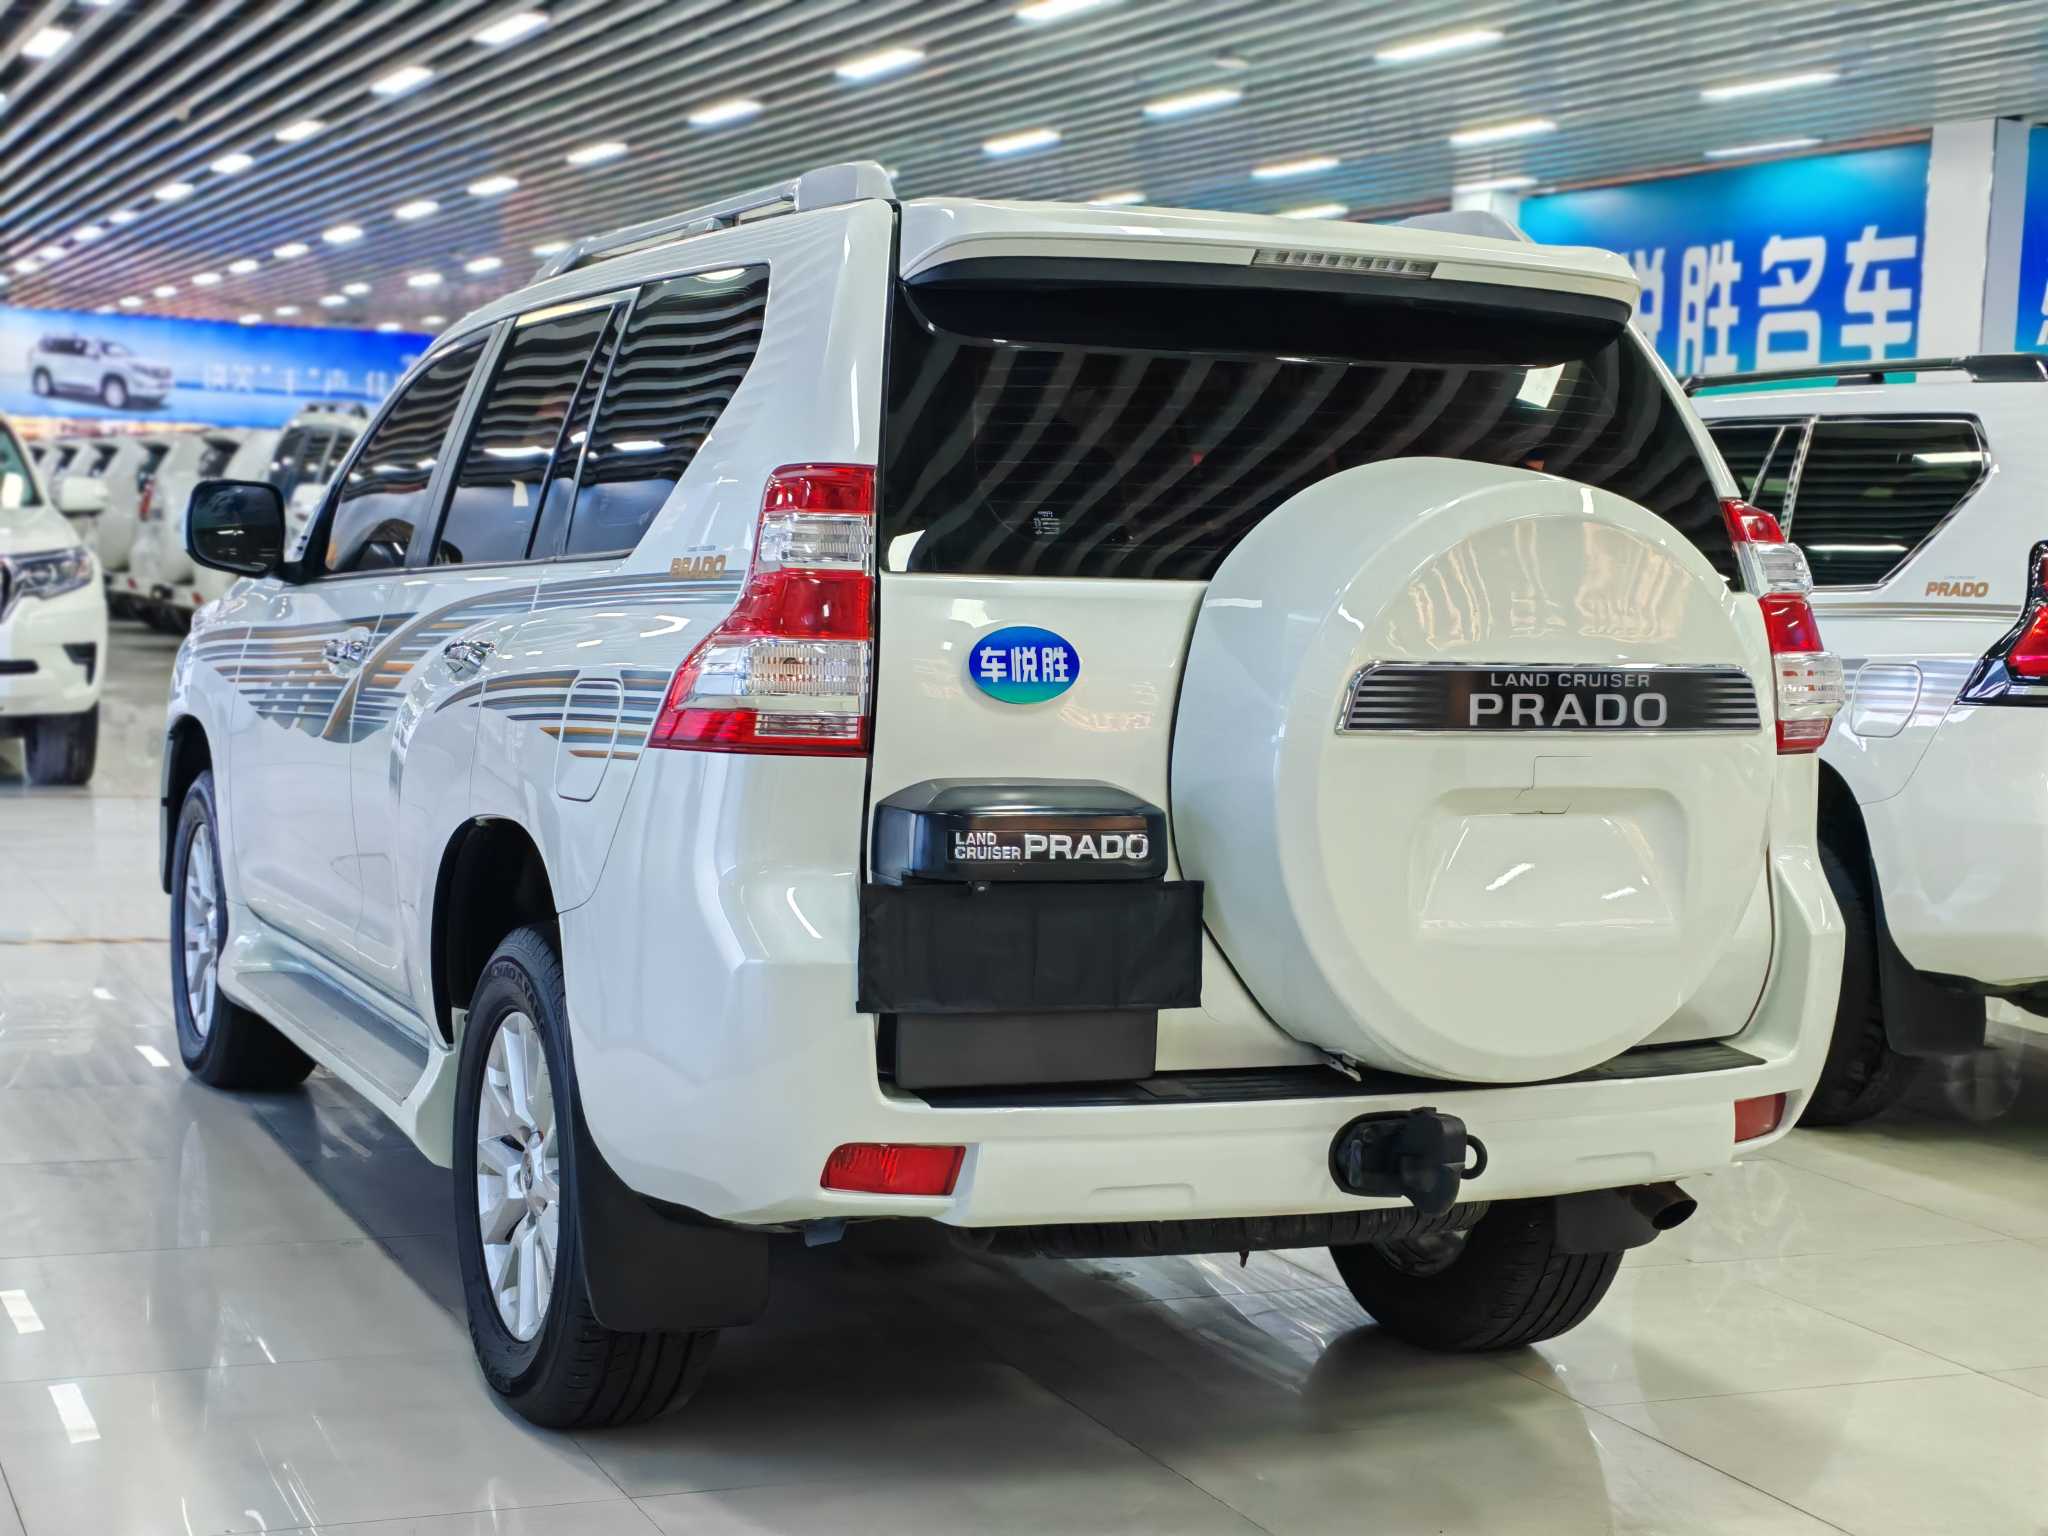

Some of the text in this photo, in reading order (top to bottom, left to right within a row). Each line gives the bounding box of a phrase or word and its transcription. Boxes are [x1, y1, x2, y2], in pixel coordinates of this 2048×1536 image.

[1925, 581, 1989, 598] PRADO
[979, 646, 1070, 683] 车悦胜
[1490, 673, 1651, 688] LAND CRUISER
[1469, 693, 1668, 727] PRADO
[954, 833, 1149, 860] CRUISER PRADO
[955, 832, 997, 846] LAND
